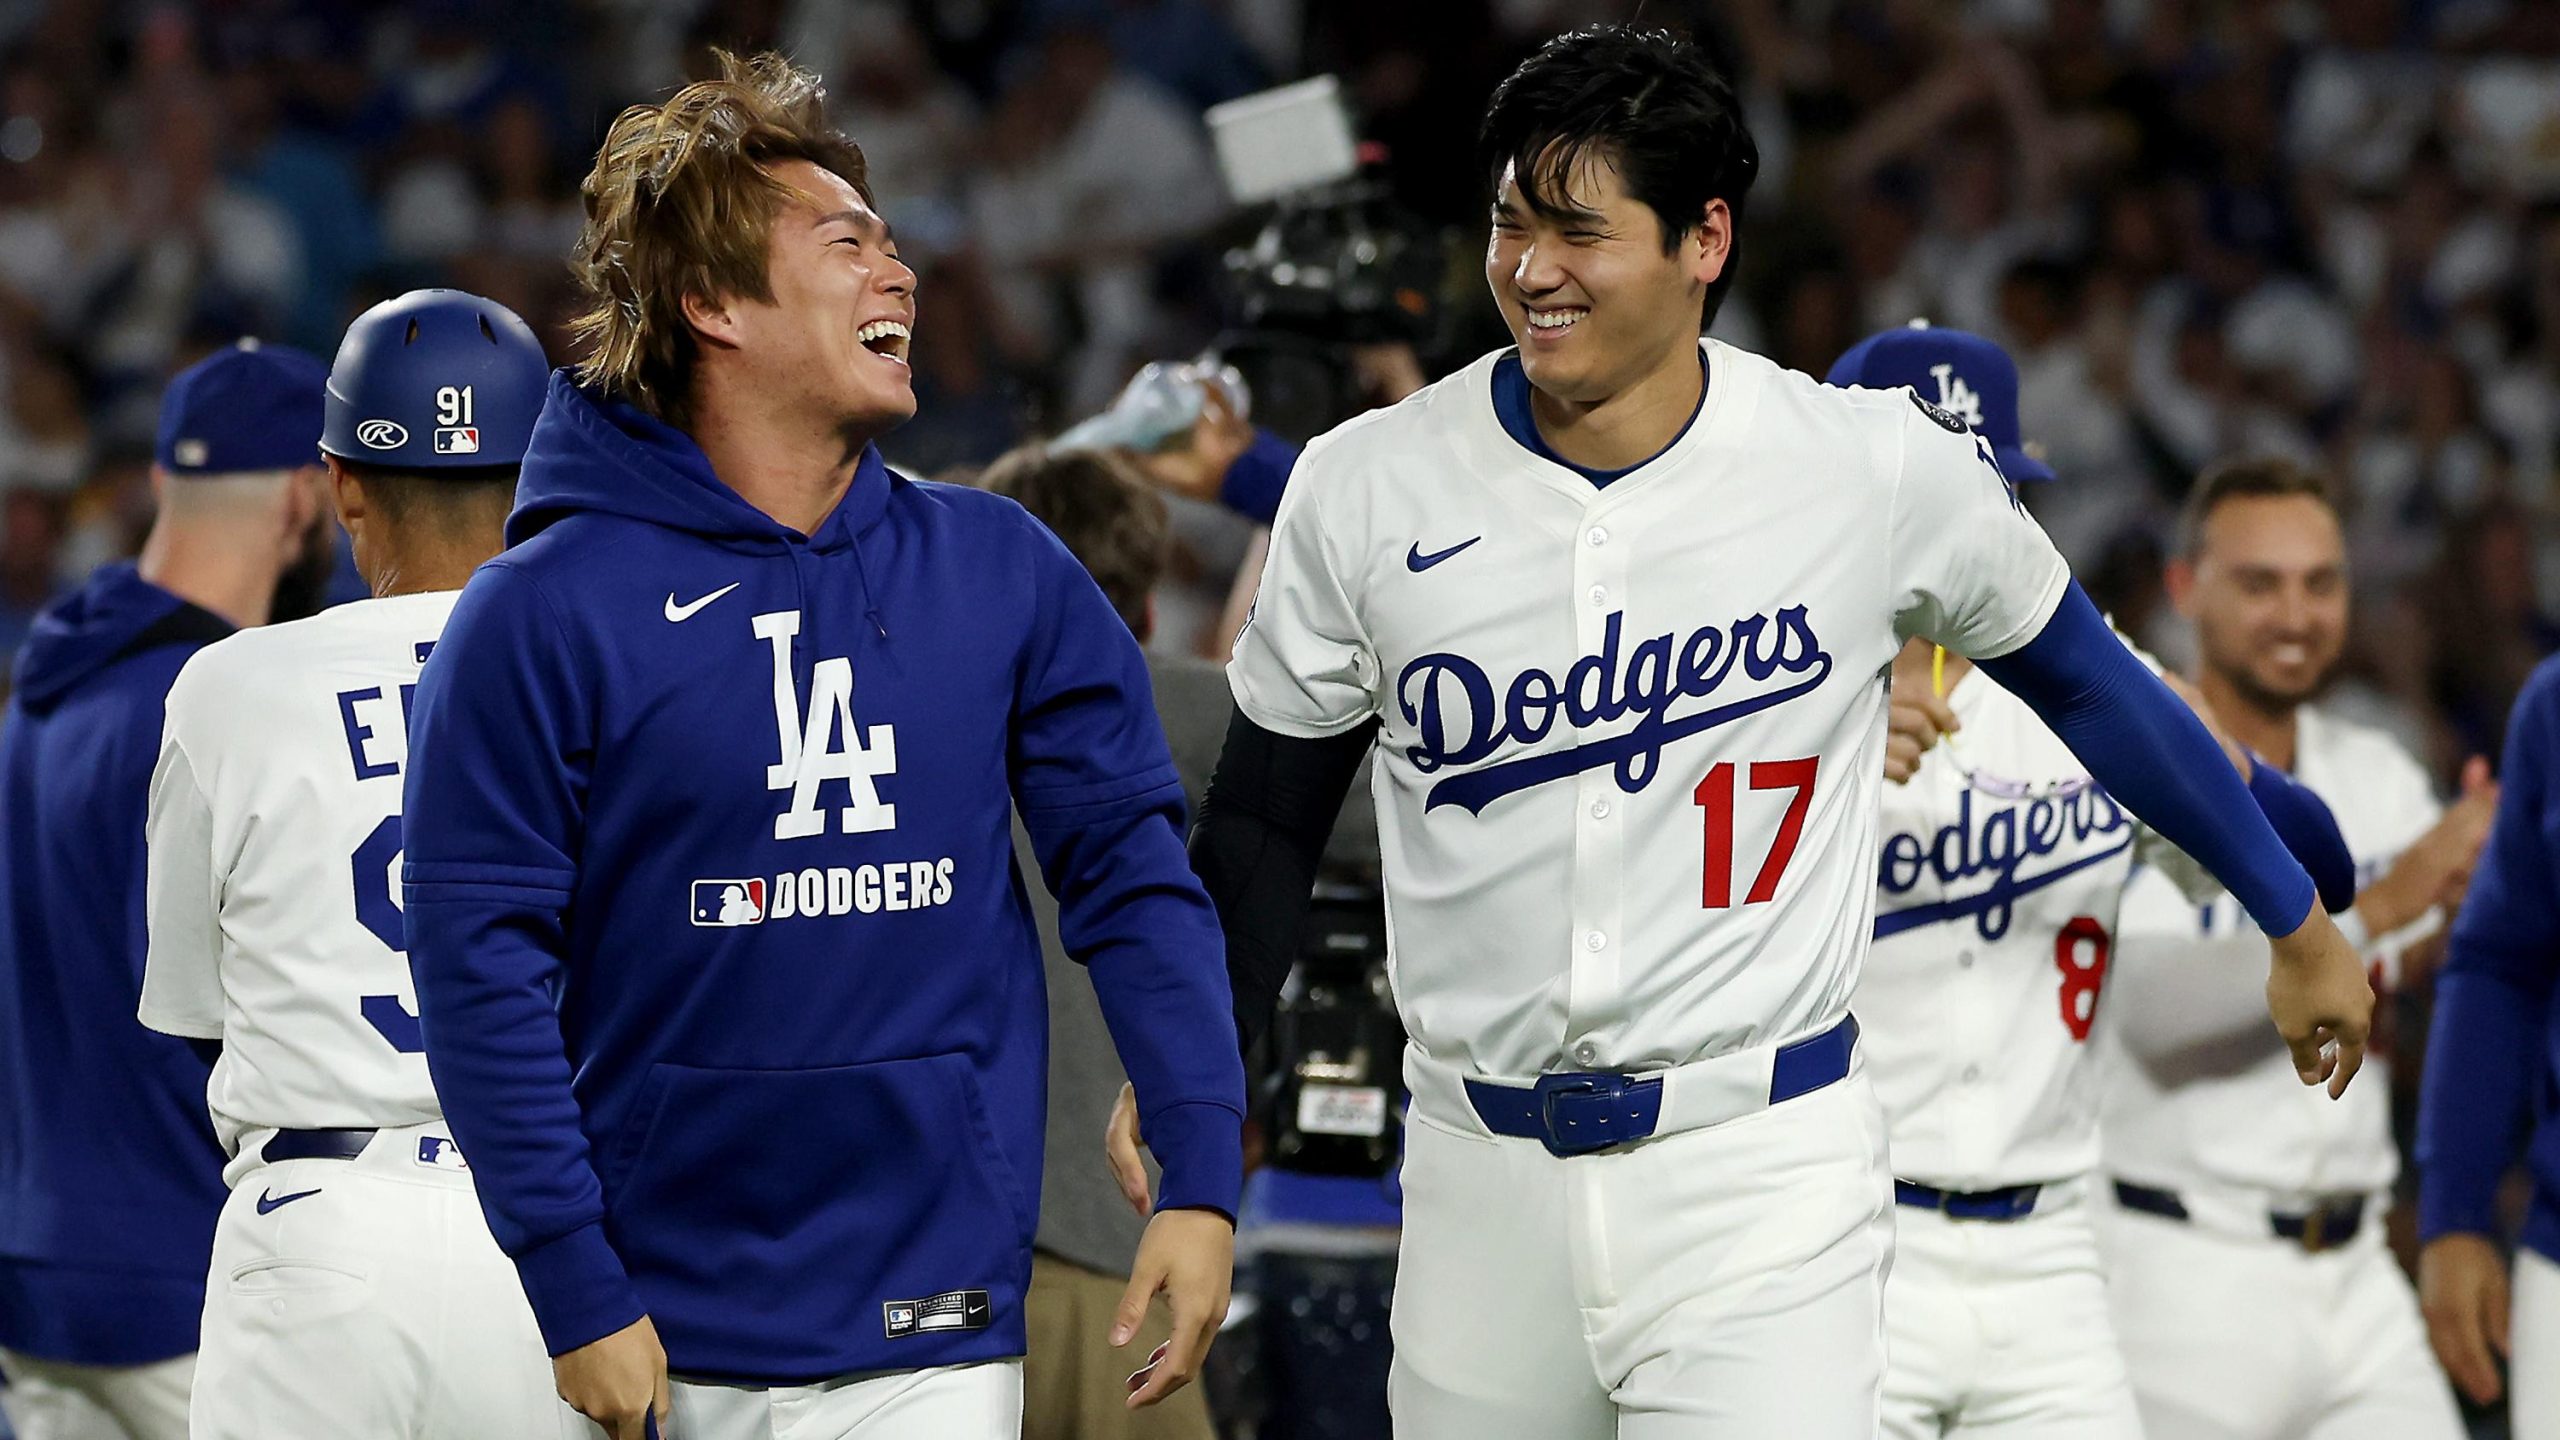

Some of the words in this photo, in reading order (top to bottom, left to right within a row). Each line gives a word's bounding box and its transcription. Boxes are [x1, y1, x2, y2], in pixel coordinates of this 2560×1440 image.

[436, 385, 473, 426] 91
[1929, 362, 1984, 426] LA
[337, 684, 416, 781] E
[751, 609, 897, 841] LA
[1397, 603, 1832, 818] Dodgers
[770, 857, 954, 919] DODGERS
[1693, 755, 1820, 909] 17
[1872, 780, 2134, 942] odgers
[2055, 916, 2109, 1044] 8
